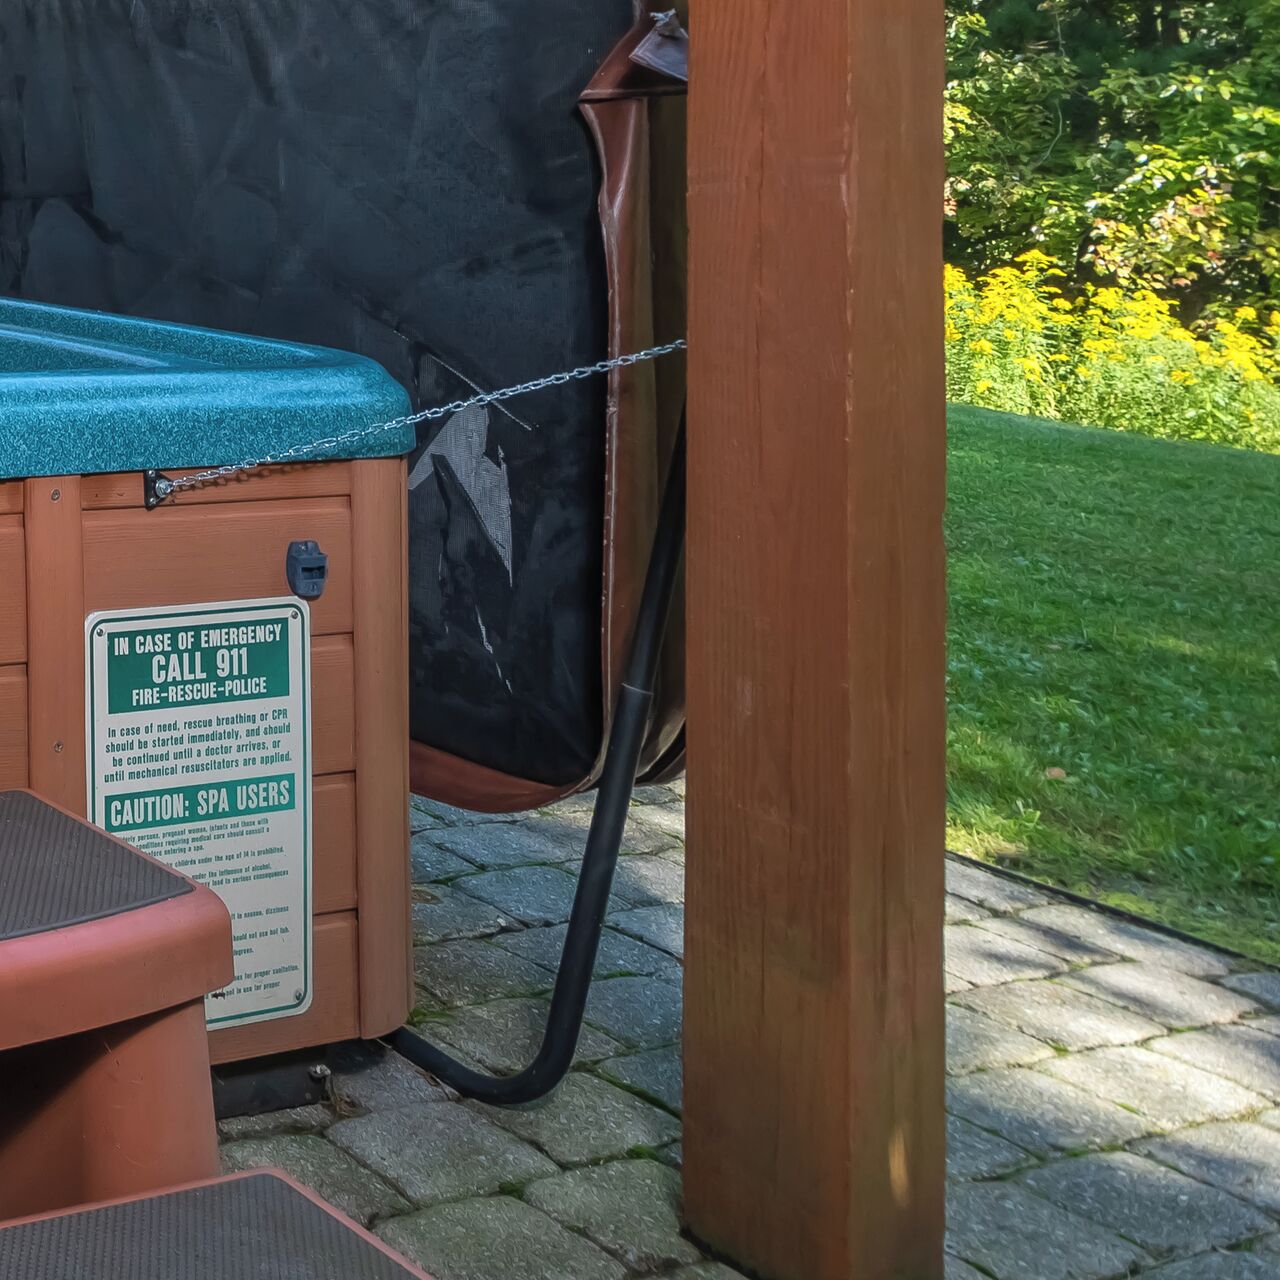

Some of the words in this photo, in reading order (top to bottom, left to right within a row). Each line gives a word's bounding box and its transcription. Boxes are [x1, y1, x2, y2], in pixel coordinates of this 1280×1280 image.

[114, 638, 128, 655] IN
[136, 634, 171, 653] CASE
[178, 631, 194, 649] OF
[201, 624, 282, 647] EMERGENCY
[152, 652, 206, 683] CALL
[217, 648, 247, 676] 911
[133, 677, 267, 706] FIRE-RESCUE-POLICE
[108, 727, 116, 737] In
[120, 727, 140, 737] case
[145, 723, 153, 733] of
[157, 721, 179, 732] need,
[184, 718, 212, 729] rescue
[217, 713, 256, 727] breathing
[260, 712, 268, 721] or
[272, 709, 288, 720] CPR
[106, 740, 134, 752] should
[138, 738, 148, 749] be
[152, 734, 184, 747] started
[187, 729, 241, 744] immediately,
[245, 726, 260, 737] and
[263, 722, 290, 735] should
[104, 770, 124, 782] until
[128, 764, 178, 779] mechanical
[181, 759, 239, 773] resuscitators
[243, 756, 256, 766] are
[260, 752, 292, 765] applied.
[113, 757, 123, 767] be
[127, 752, 169, 765] continued
[173, 749, 193, 759] until
[197, 749, 201, 757] a
[205, 745, 232, 757] doctor
[236, 741, 268, 753] arrives,
[272, 740, 281, 748] or
[111, 793, 189, 826] CAUTION:
[197, 788, 229, 814] SPA
[237, 780, 289, 809] USERS
[162, 829, 186, 839] pregnant
[209, 824, 228, 832] infants
[165, 836, 189, 846] requiring
[191, 834, 211, 843] medical
[227, 830, 244, 838] should
[246, 828, 264, 836] consult
[164, 846, 186, 855] entering
[194, 844, 204, 852] spa.
[225, 853, 234, 861] age
[212, 878, 224, 886] lead
[233, 874, 252, 883] serious
[219, 867, 243, 876] influence
